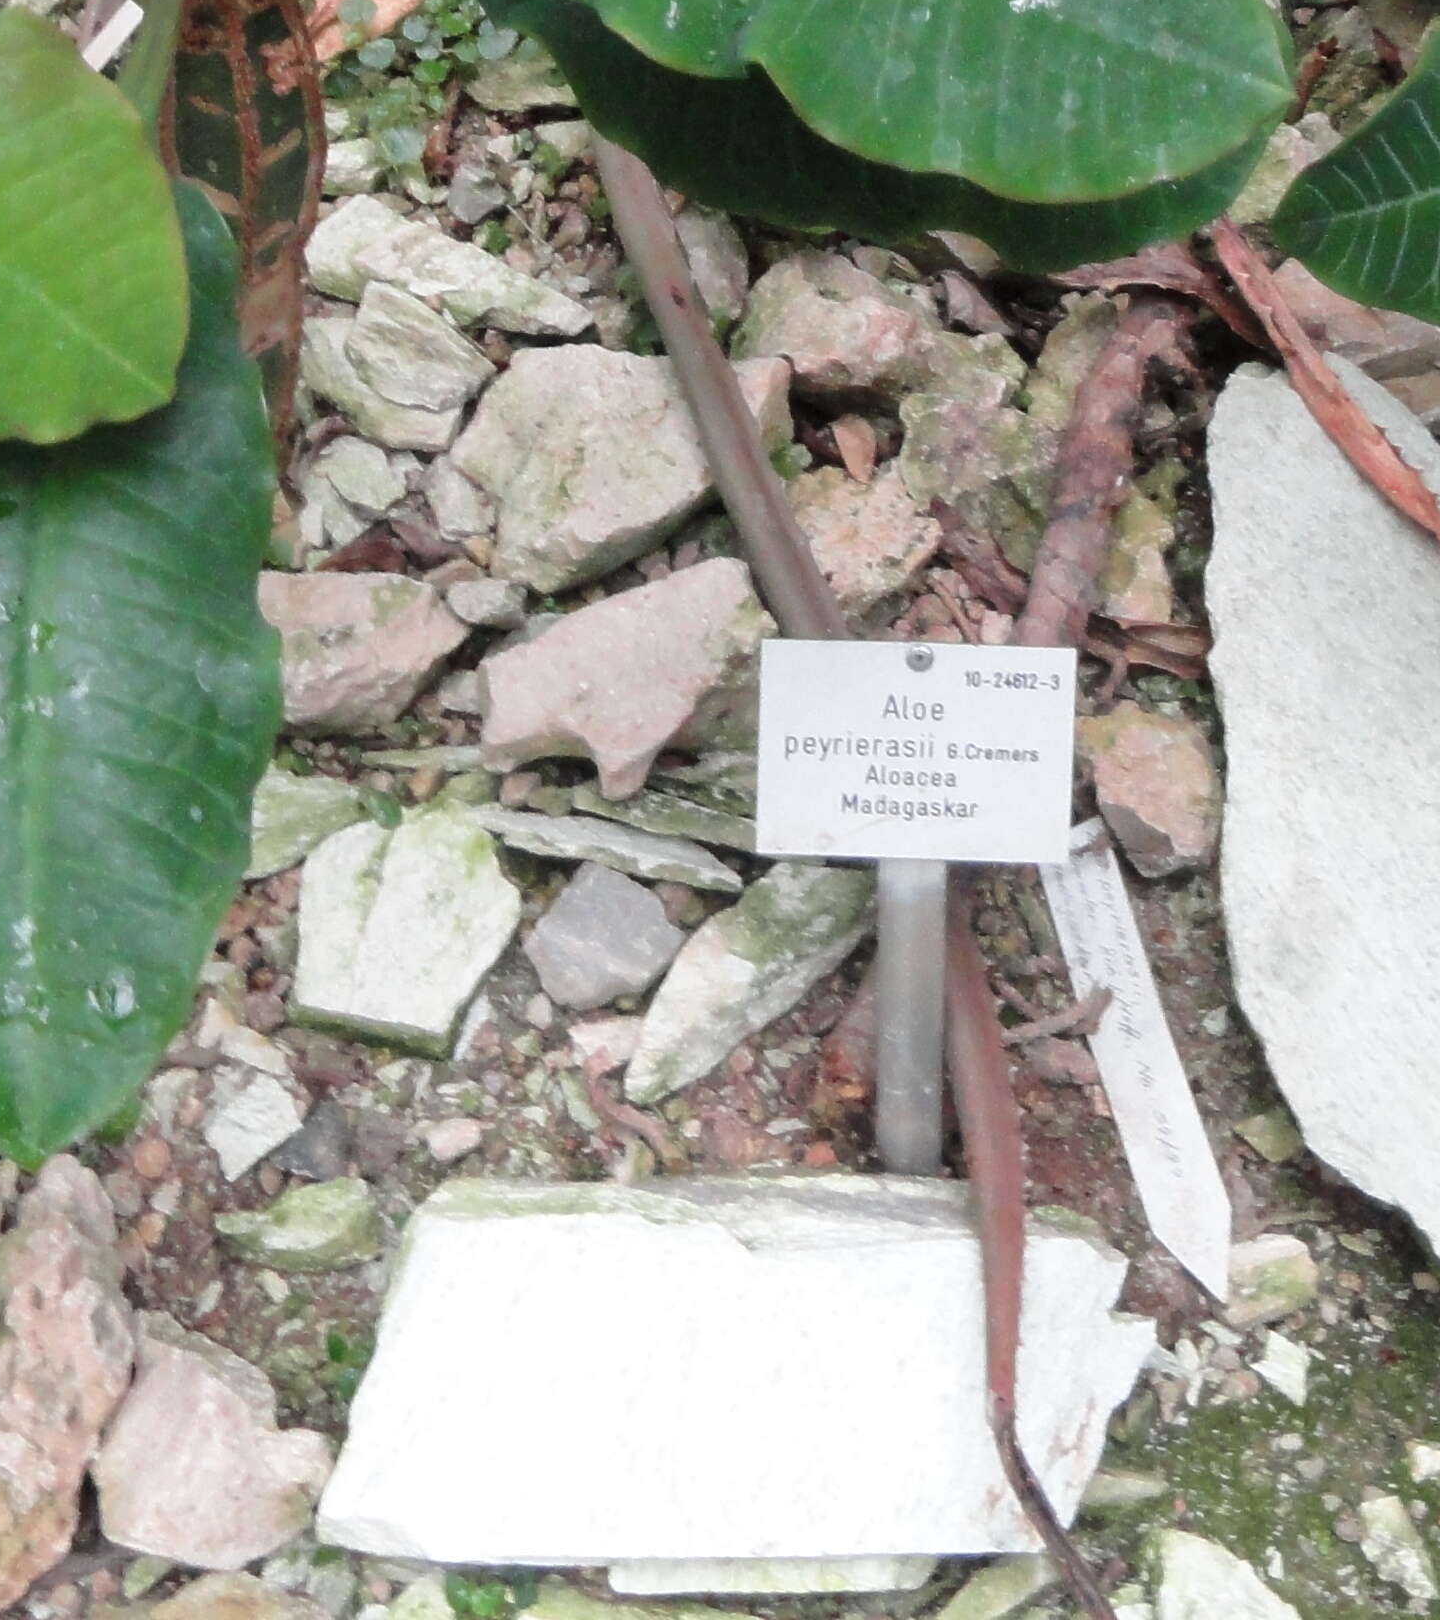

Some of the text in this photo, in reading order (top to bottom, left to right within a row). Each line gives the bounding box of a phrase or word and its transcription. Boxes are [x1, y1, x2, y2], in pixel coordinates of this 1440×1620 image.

[882, 694, 945, 722] Aloe
[783, 730, 936, 762] peyrierasii
[865, 763, 958, 788] Aloacea
[840, 792, 979, 822] Madagaskar
